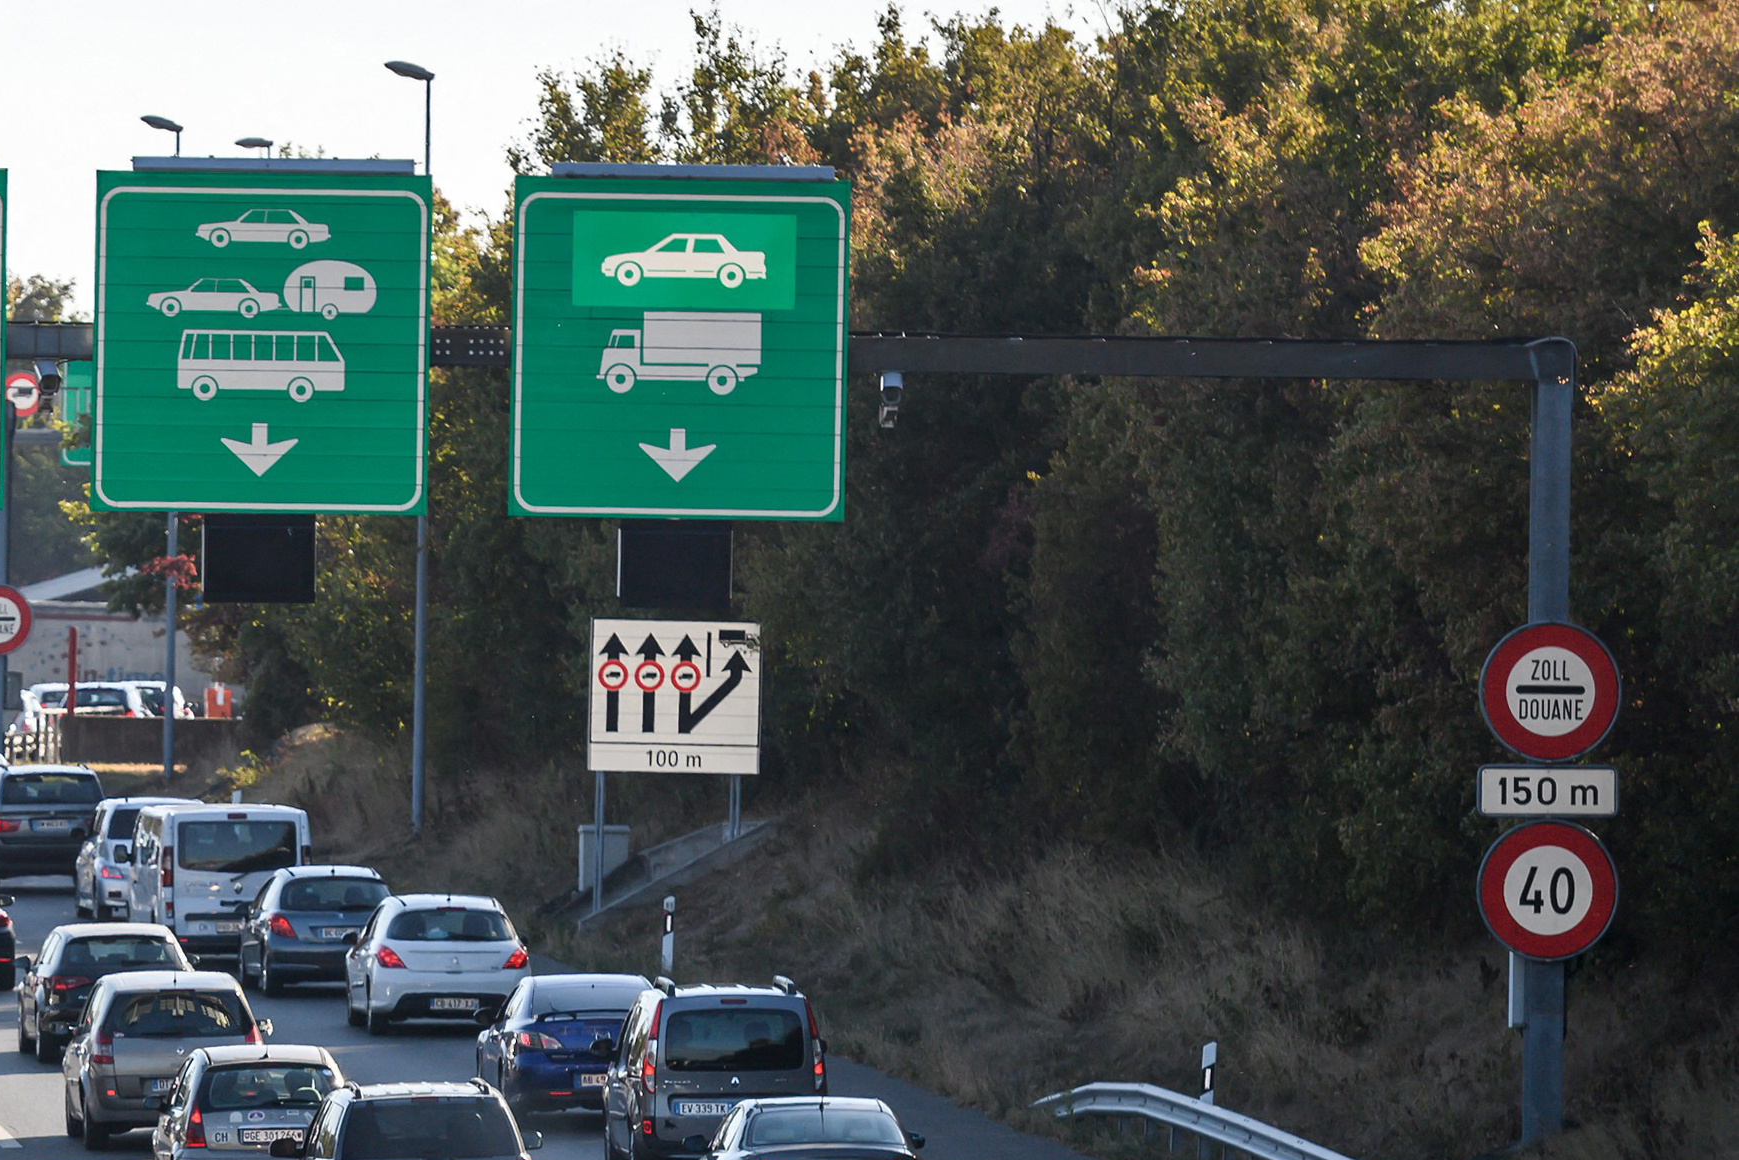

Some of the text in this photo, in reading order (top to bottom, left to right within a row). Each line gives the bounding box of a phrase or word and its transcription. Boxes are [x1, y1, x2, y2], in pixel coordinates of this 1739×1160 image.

[1530, 659, 1571, 682] ZOLL
[1518, 699, 1584, 721] DOUANE
[645, 749, 702, 768] 100 m
[1498, 776, 1599, 806] 150 m
[1518, 865, 1576, 915] 40
[214, 1132, 229, 1142] CH
